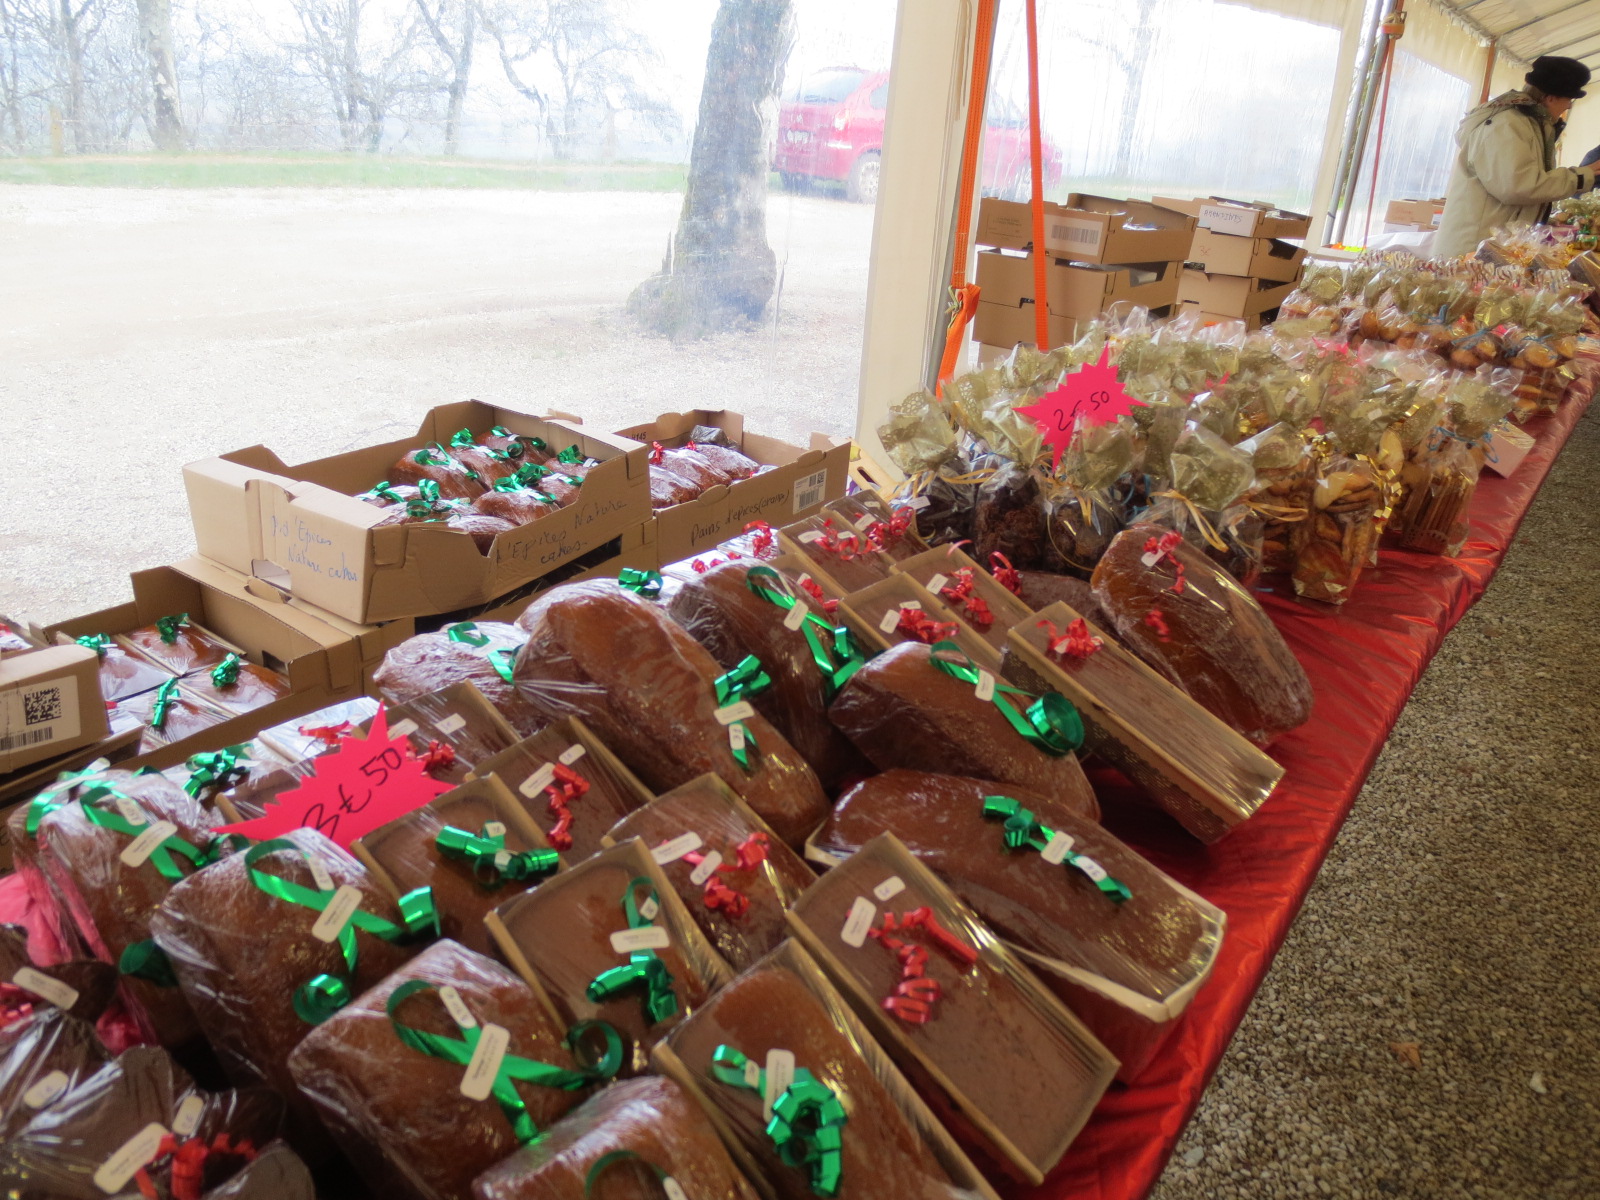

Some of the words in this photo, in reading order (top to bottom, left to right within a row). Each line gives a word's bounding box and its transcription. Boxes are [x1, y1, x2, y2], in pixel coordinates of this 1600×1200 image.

[1090, 391, 1110, 411] 50
[574, 500, 627, 529] Nature
[690, 520, 721, 547] Pains
[358, 747, 402, 787] 50
